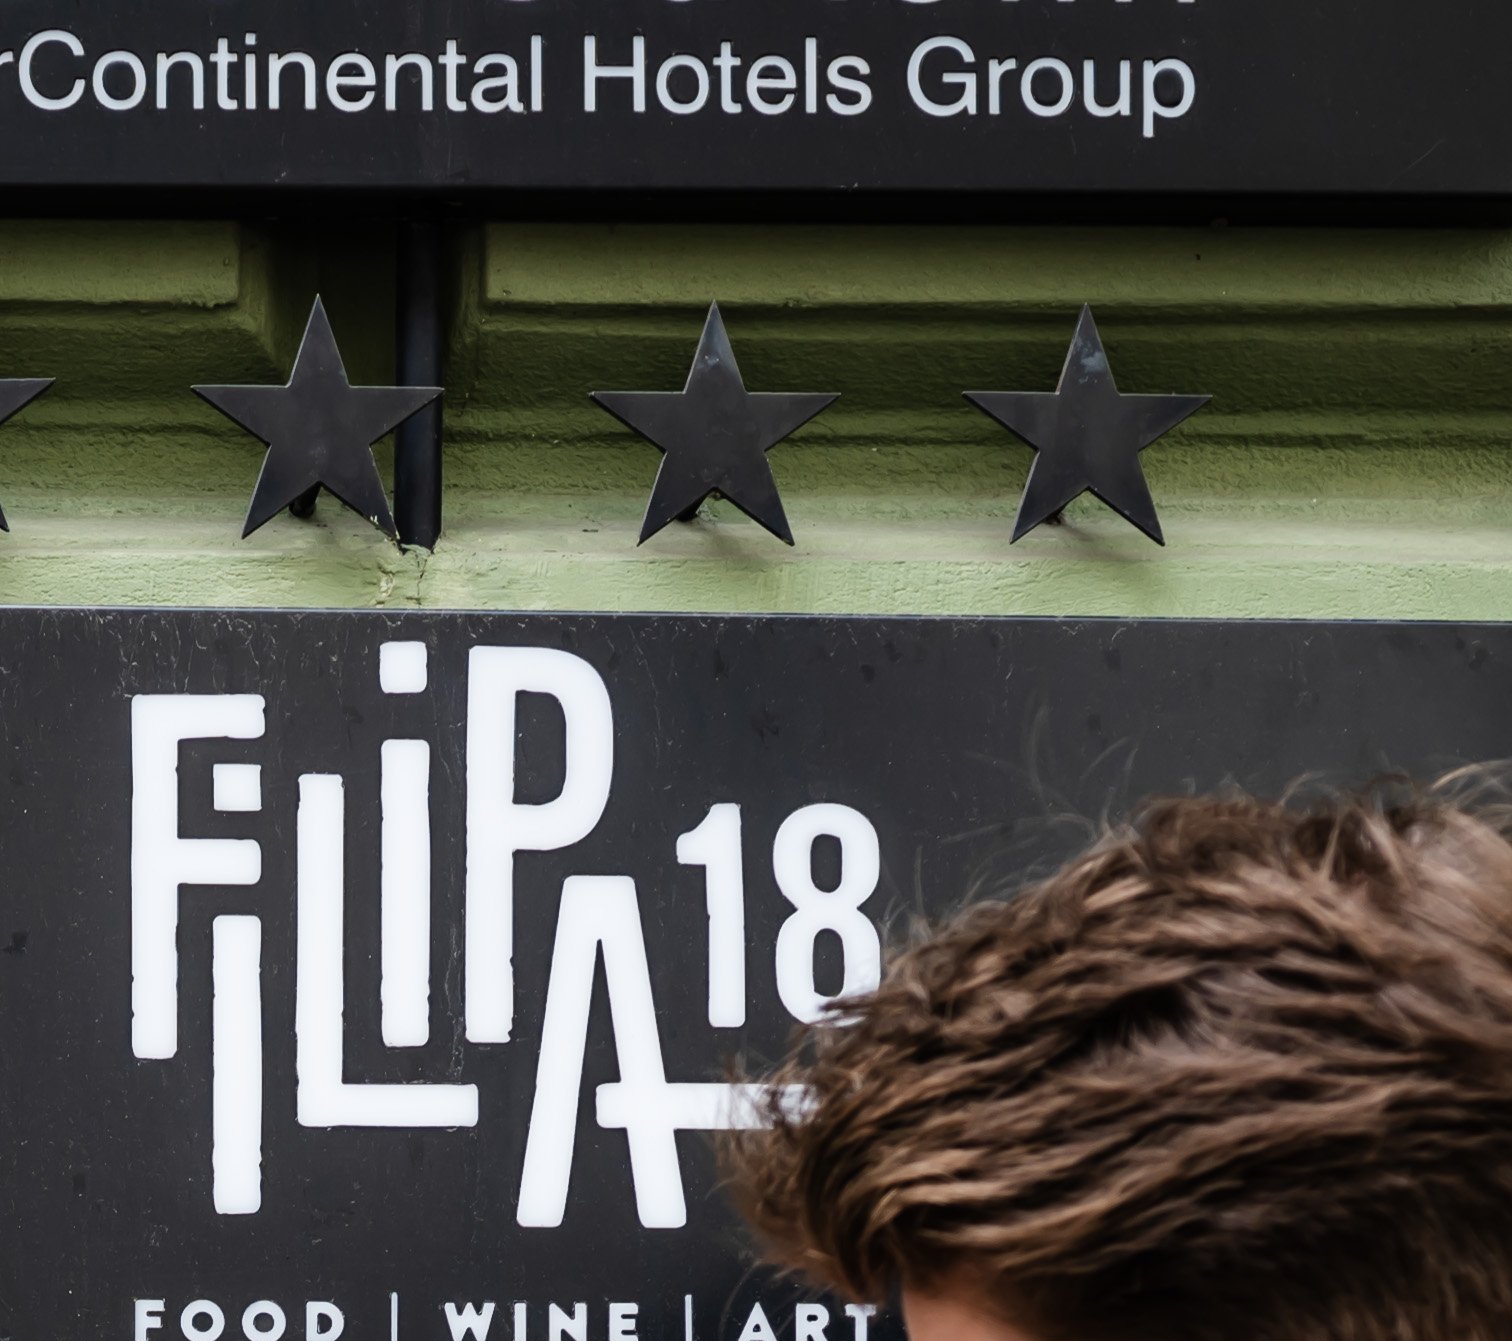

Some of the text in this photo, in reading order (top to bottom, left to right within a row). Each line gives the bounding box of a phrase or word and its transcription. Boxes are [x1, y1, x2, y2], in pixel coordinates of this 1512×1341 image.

[583, 35, 873, 116] Hotels
[906, 36, 1197, 138] Group
[676, 802, 881, 1027] 18
